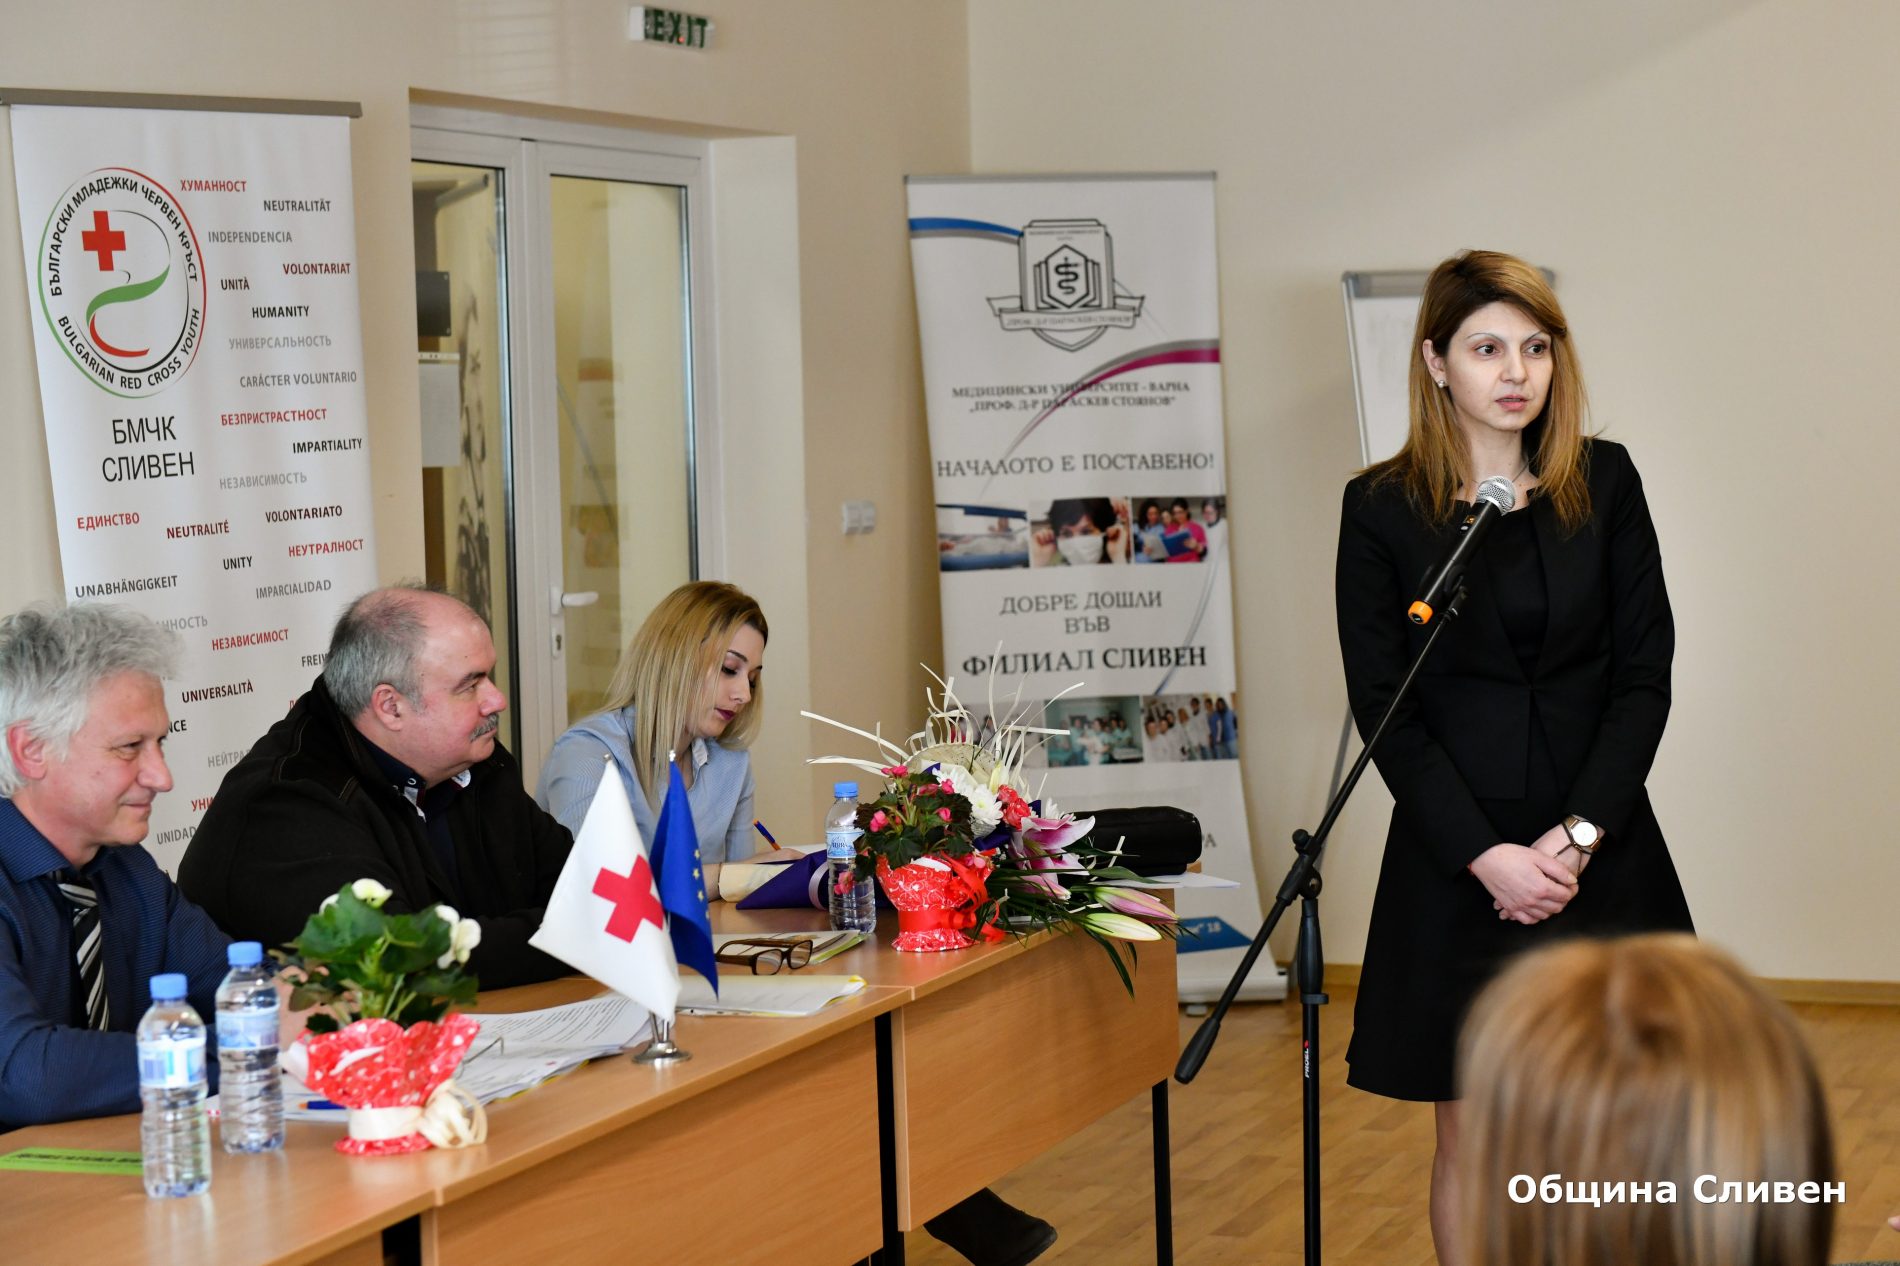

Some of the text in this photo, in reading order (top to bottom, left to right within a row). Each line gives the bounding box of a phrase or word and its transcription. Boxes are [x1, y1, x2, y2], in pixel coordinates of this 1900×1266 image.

[653, 8, 707, 48] EXIT
[180, 180, 247, 193] ХУМАННОСТ
[263, 198, 331, 212] NEUTRALITÄT
[49, 175, 198, 296] БЪЛГАРСКИ МЛАДЕЖКИ ЧЕРВЕН КРЪСТ
[208, 231, 293, 244] INDEPENDENCIA
[282, 262, 351, 275] VOLONTARIAT
[220, 278, 250, 291] UNITÀ
[252, 305, 310, 318] HUMANITY
[58, 308, 200, 390] BULGARIAN RED CROSS YOUTH
[229, 335, 332, 350] УНИВЕРСАЛЬНОСТЬ
[240, 371, 357, 388] CARÁCTER VOLUNTARIO
[221, 408, 327, 426] БЕЗПРИСТРАСТНОСТ
[112, 416, 177, 444] БМЧК
[293, 438, 362, 453] IMPARTIALITY
[102, 452, 195, 482] СЛИВЕН
[937, 454, 1214, 478] НАЧАЛОТО Е ПОСТАВЕНО!
[219, 471, 307, 490] НЕЗАВИСИМОСТЬ
[77, 512, 140, 529] ЕДИНСТВО
[265, 505, 343, 522] VOLONTARIATO
[167, 520, 230, 538] NEUTRALITÉ
[288, 539, 364, 557] НЕУТРАЛНОСТ
[223, 556, 253, 570] UNITY
[75, 575, 178, 598] UNABHÄNGIGKEIT
[256, 579, 332, 599] IMPARCIALIDAD
[999, 590, 1162, 615] ДОБРЕ ДОШЛИ
[1065, 616, 1110, 634] ВЪВ
[212, 629, 289, 650] НЕЗАВИСИМОСТ
[963, 646, 1207, 676] ФИЛИАЛ СЛИВЕН
[182, 680, 253, 703] UNIVERSALITÀ
